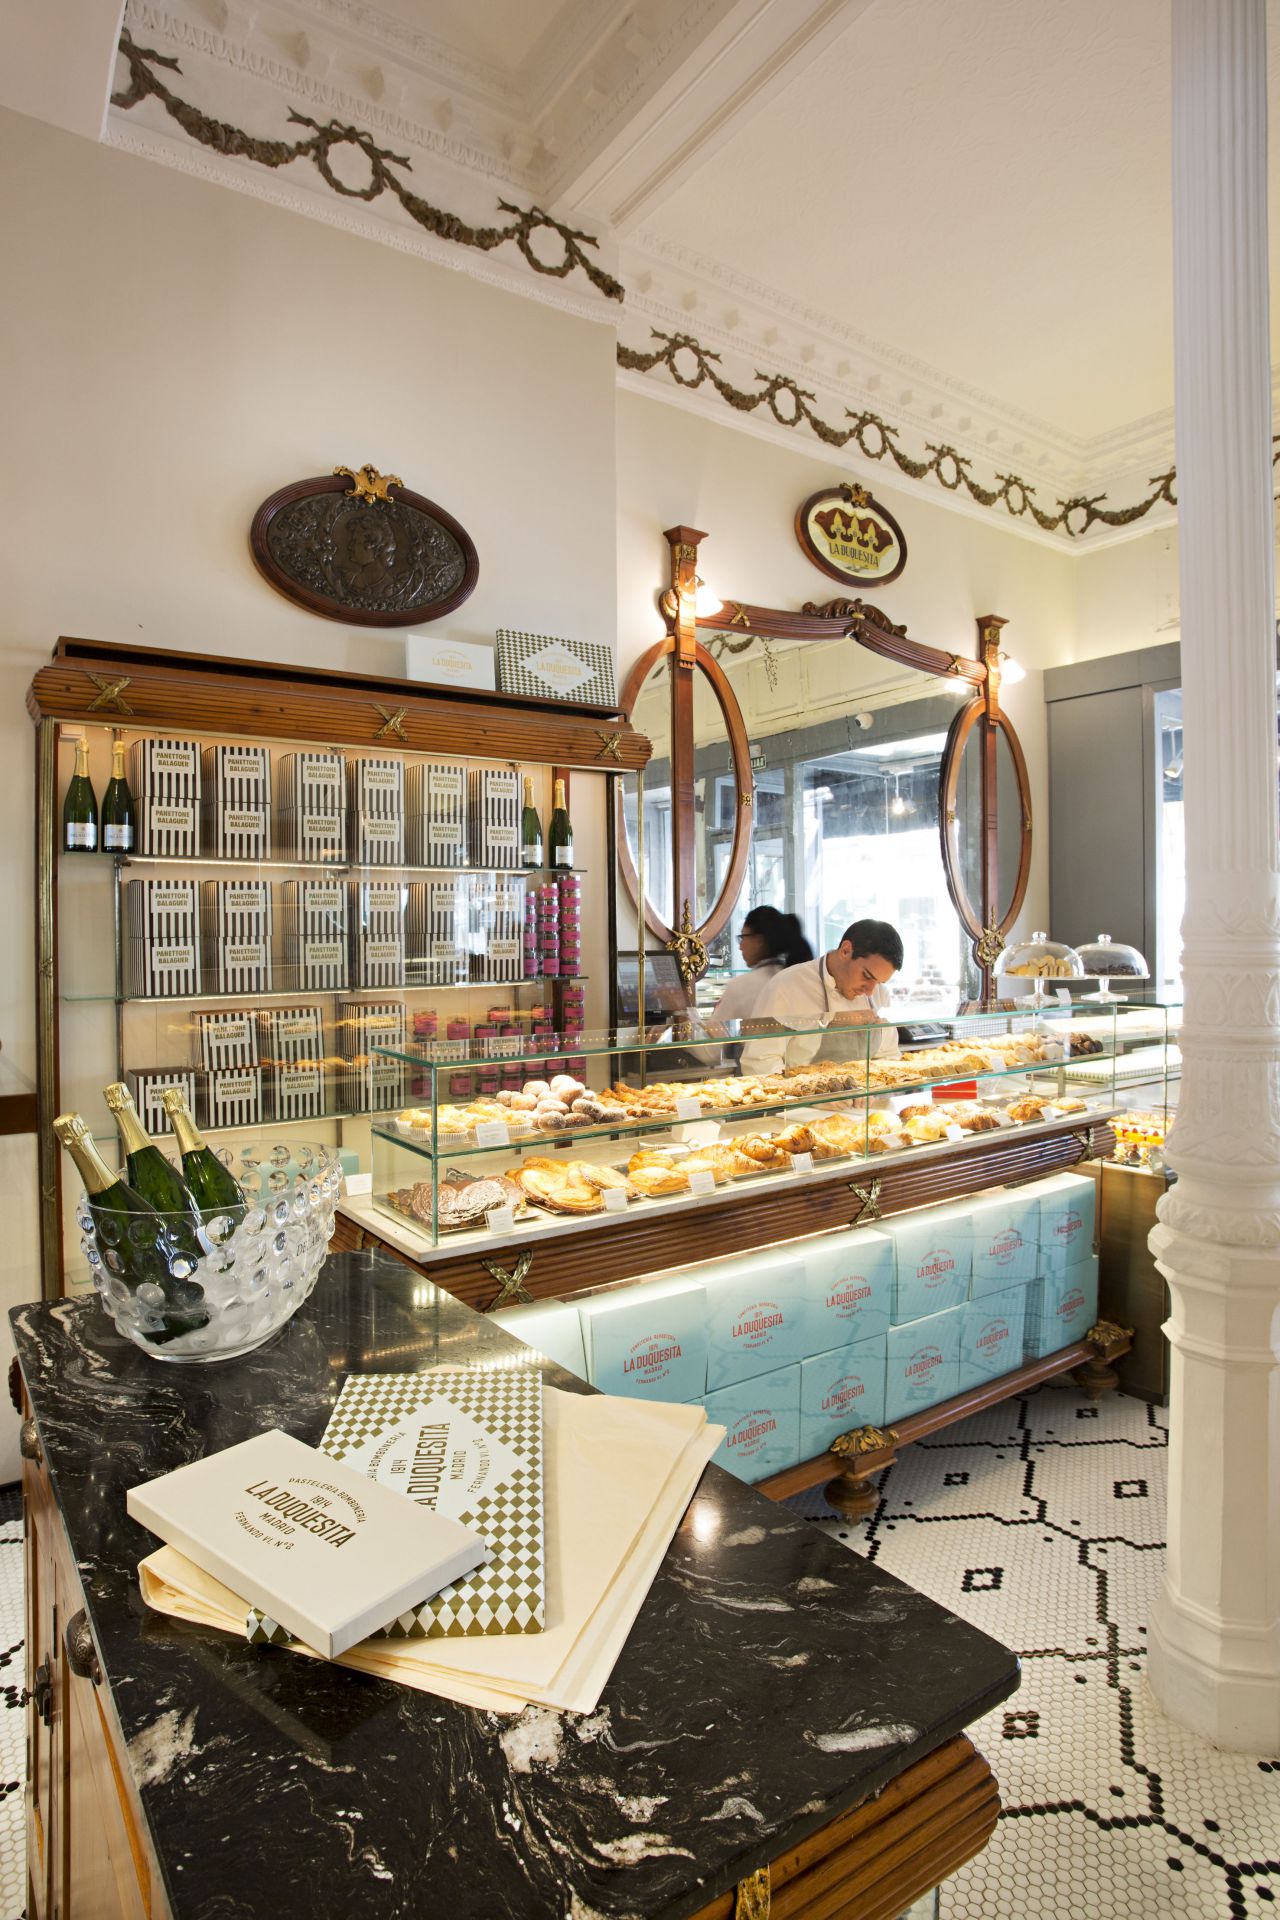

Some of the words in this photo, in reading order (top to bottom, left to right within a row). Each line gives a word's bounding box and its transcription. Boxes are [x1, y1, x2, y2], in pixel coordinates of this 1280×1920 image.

[829, 543, 839, 554] LA
[156, 752, 191, 761] PANETTONE
[228, 758, 260, 766] PANETTONE
[306, 765, 337, 773] PANETTONE
[156, 810, 190, 818] PANETTONE
[228, 814, 261, 822] PANETTONE
[157, 817, 188, 825] BALAGUER
[230, 821, 260, 829] BALAGUER
[155, 892, 189, 900] PANETTONE
[308, 892, 339, 900] PANETTONE
[156, 950, 190, 958] PANETTONE
[158, 956, 189, 964] BALAGUER
[215, 1032, 245, 1040] BALAGUER
[220, 1080, 253, 1089] PANETTONE
[222, 1088, 251, 1096] BALAGUER
[916, 1266, 925, 1278] LA
[826, 1295, 836, 1308] LA
[836, 1286, 872, 1305] DUQUESITA
[732, 1323, 743, 1338] LA
[744, 1312, 784, 1334] DUQUESITA
[624, 1358, 636, 1374] LA
[637, 1344, 682, 1370] DUQUESITA
[822, 1397, 831, 1411] LA
[831, 1384, 865, 1407] DUQUESITA
[726, 1434, 738, 1448] LA
[738, 1418, 777, 1444] DUQUESITA
[406, 1422, 450, 1494] DUQUESITA
[390, 1459, 408, 1474] 1914
[450, 1450, 466, 1480] MADRID
[468, 1459, 490, 1494] FERNANDO
[310, 1495, 332, 1508] 1914
[244, 1480, 279, 1500] LA
[264, 1491, 356, 1548] DUQUESITA
[234, 1511, 264, 1538] FERNANDO
[259, 1512, 296, 1535] MADRID
